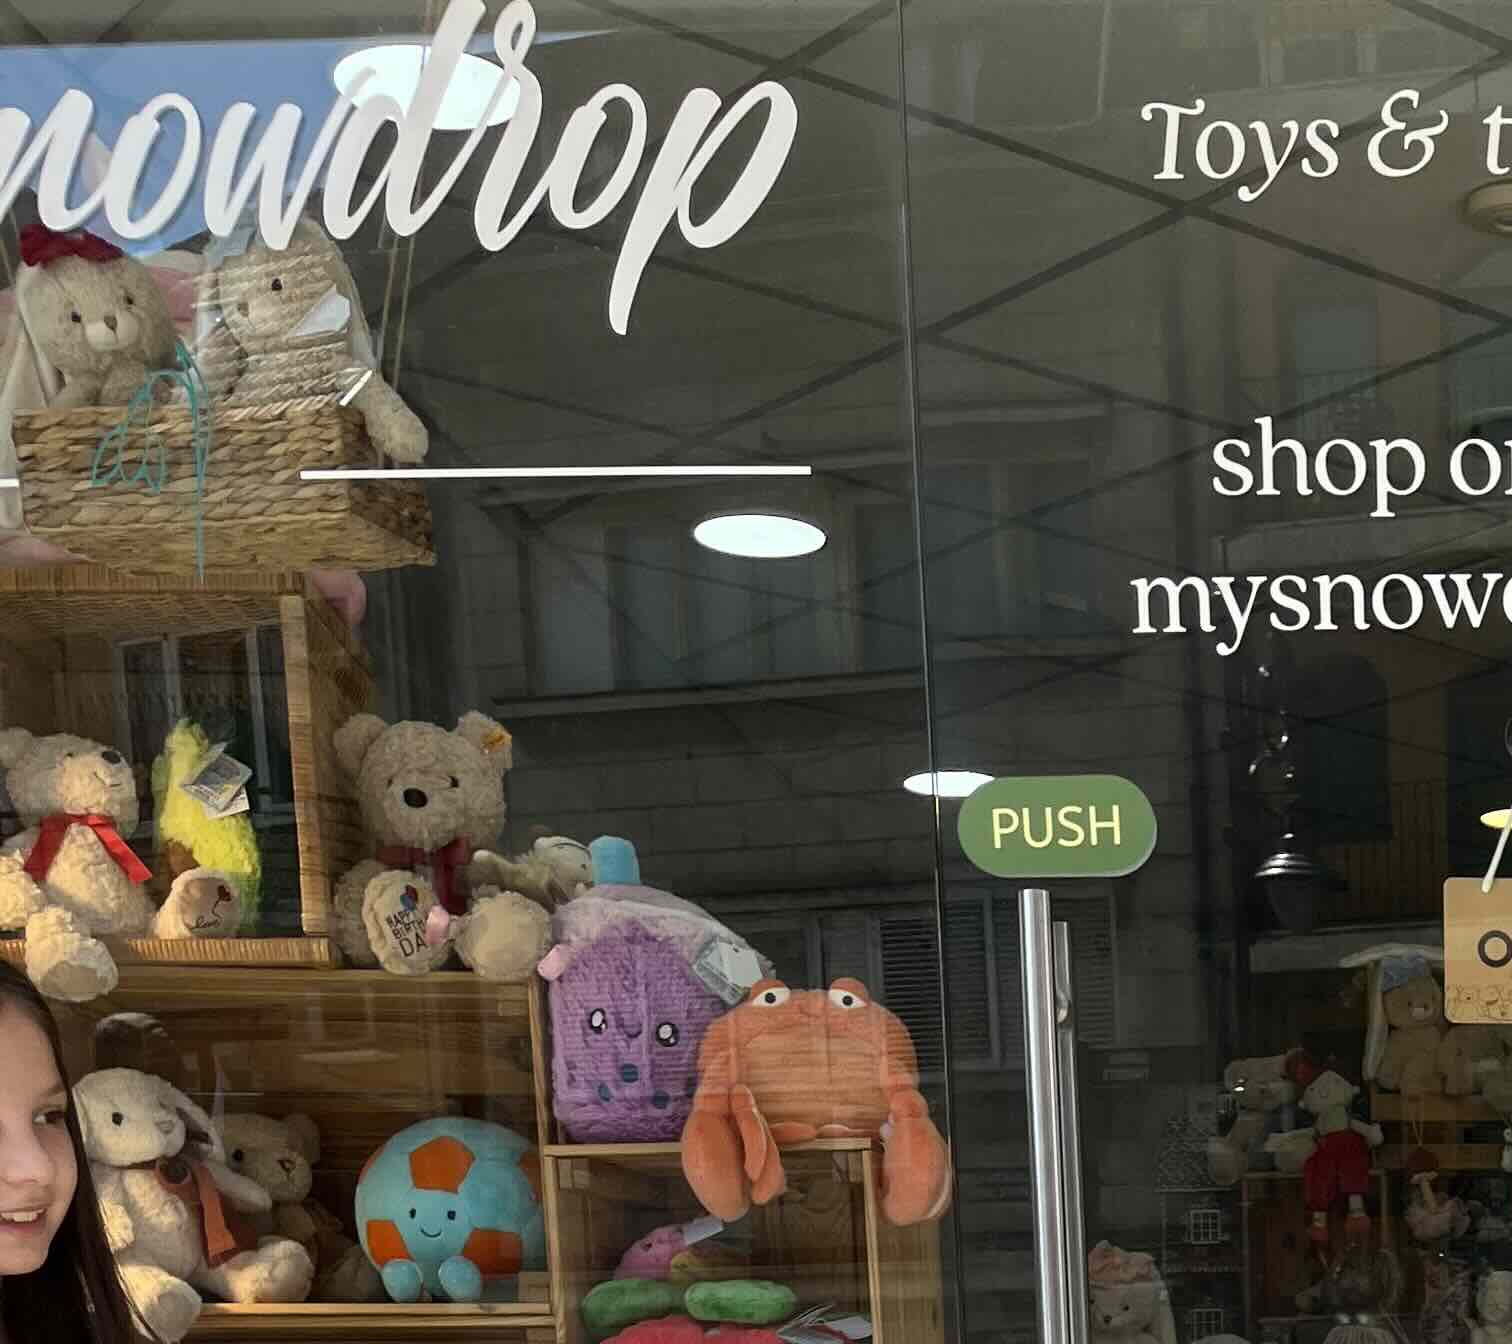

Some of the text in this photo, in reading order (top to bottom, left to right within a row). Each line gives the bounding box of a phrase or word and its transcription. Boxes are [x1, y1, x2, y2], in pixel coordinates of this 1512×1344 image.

[1141, 98, 1341, 201] Toys
[1366, 89, 1449, 178] &
[1211, 416, 1426, 519] shop
[992, 806, 1122, 850] PUSH
[398, 932, 429, 958] DA
